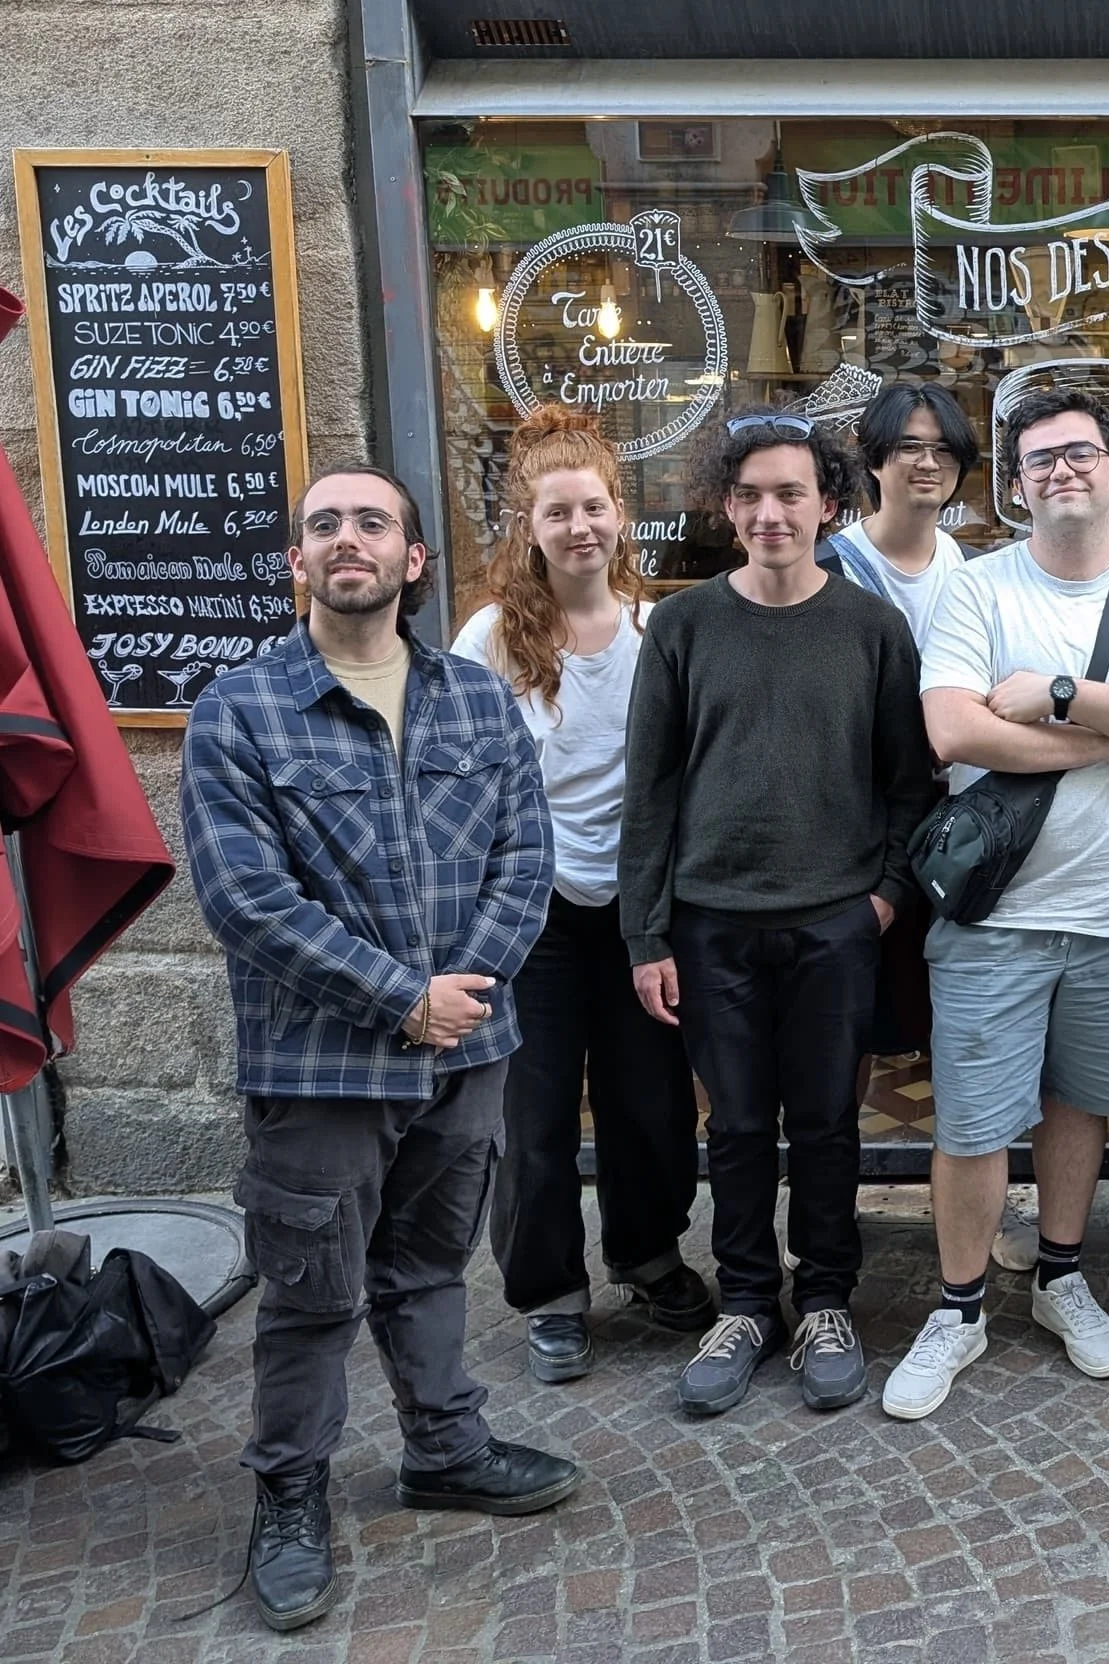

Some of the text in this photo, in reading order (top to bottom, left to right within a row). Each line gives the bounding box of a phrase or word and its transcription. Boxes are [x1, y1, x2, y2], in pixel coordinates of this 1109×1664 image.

[50, 172, 241, 262] Les Cocktails
[638, 227, 676, 261] 21€
[956, 244, 1033, 312] NOS
[137, 282, 218, 314] APEROL
[551, 290, 623, 329] Tare
[74, 321, 142, 345] SUZE
[579, 335, 665, 368] Entière
[542, 363, 669, 413] à Emporter
[72, 428, 233, 463] Cosmopolitan
[77, 473, 160, 498] MOSCOW
[165, 473, 218, 498] MULE
[78, 510, 149, 536] London
[154, 510, 213, 535] Mule
[85, 548, 192, 580] Jamaican
[193, 552, 248, 581] Mule
[84, 593, 184, 617] EXPRESSO
[87, 632, 173, 658] JOSY
[170, 634, 254, 661] BOND
